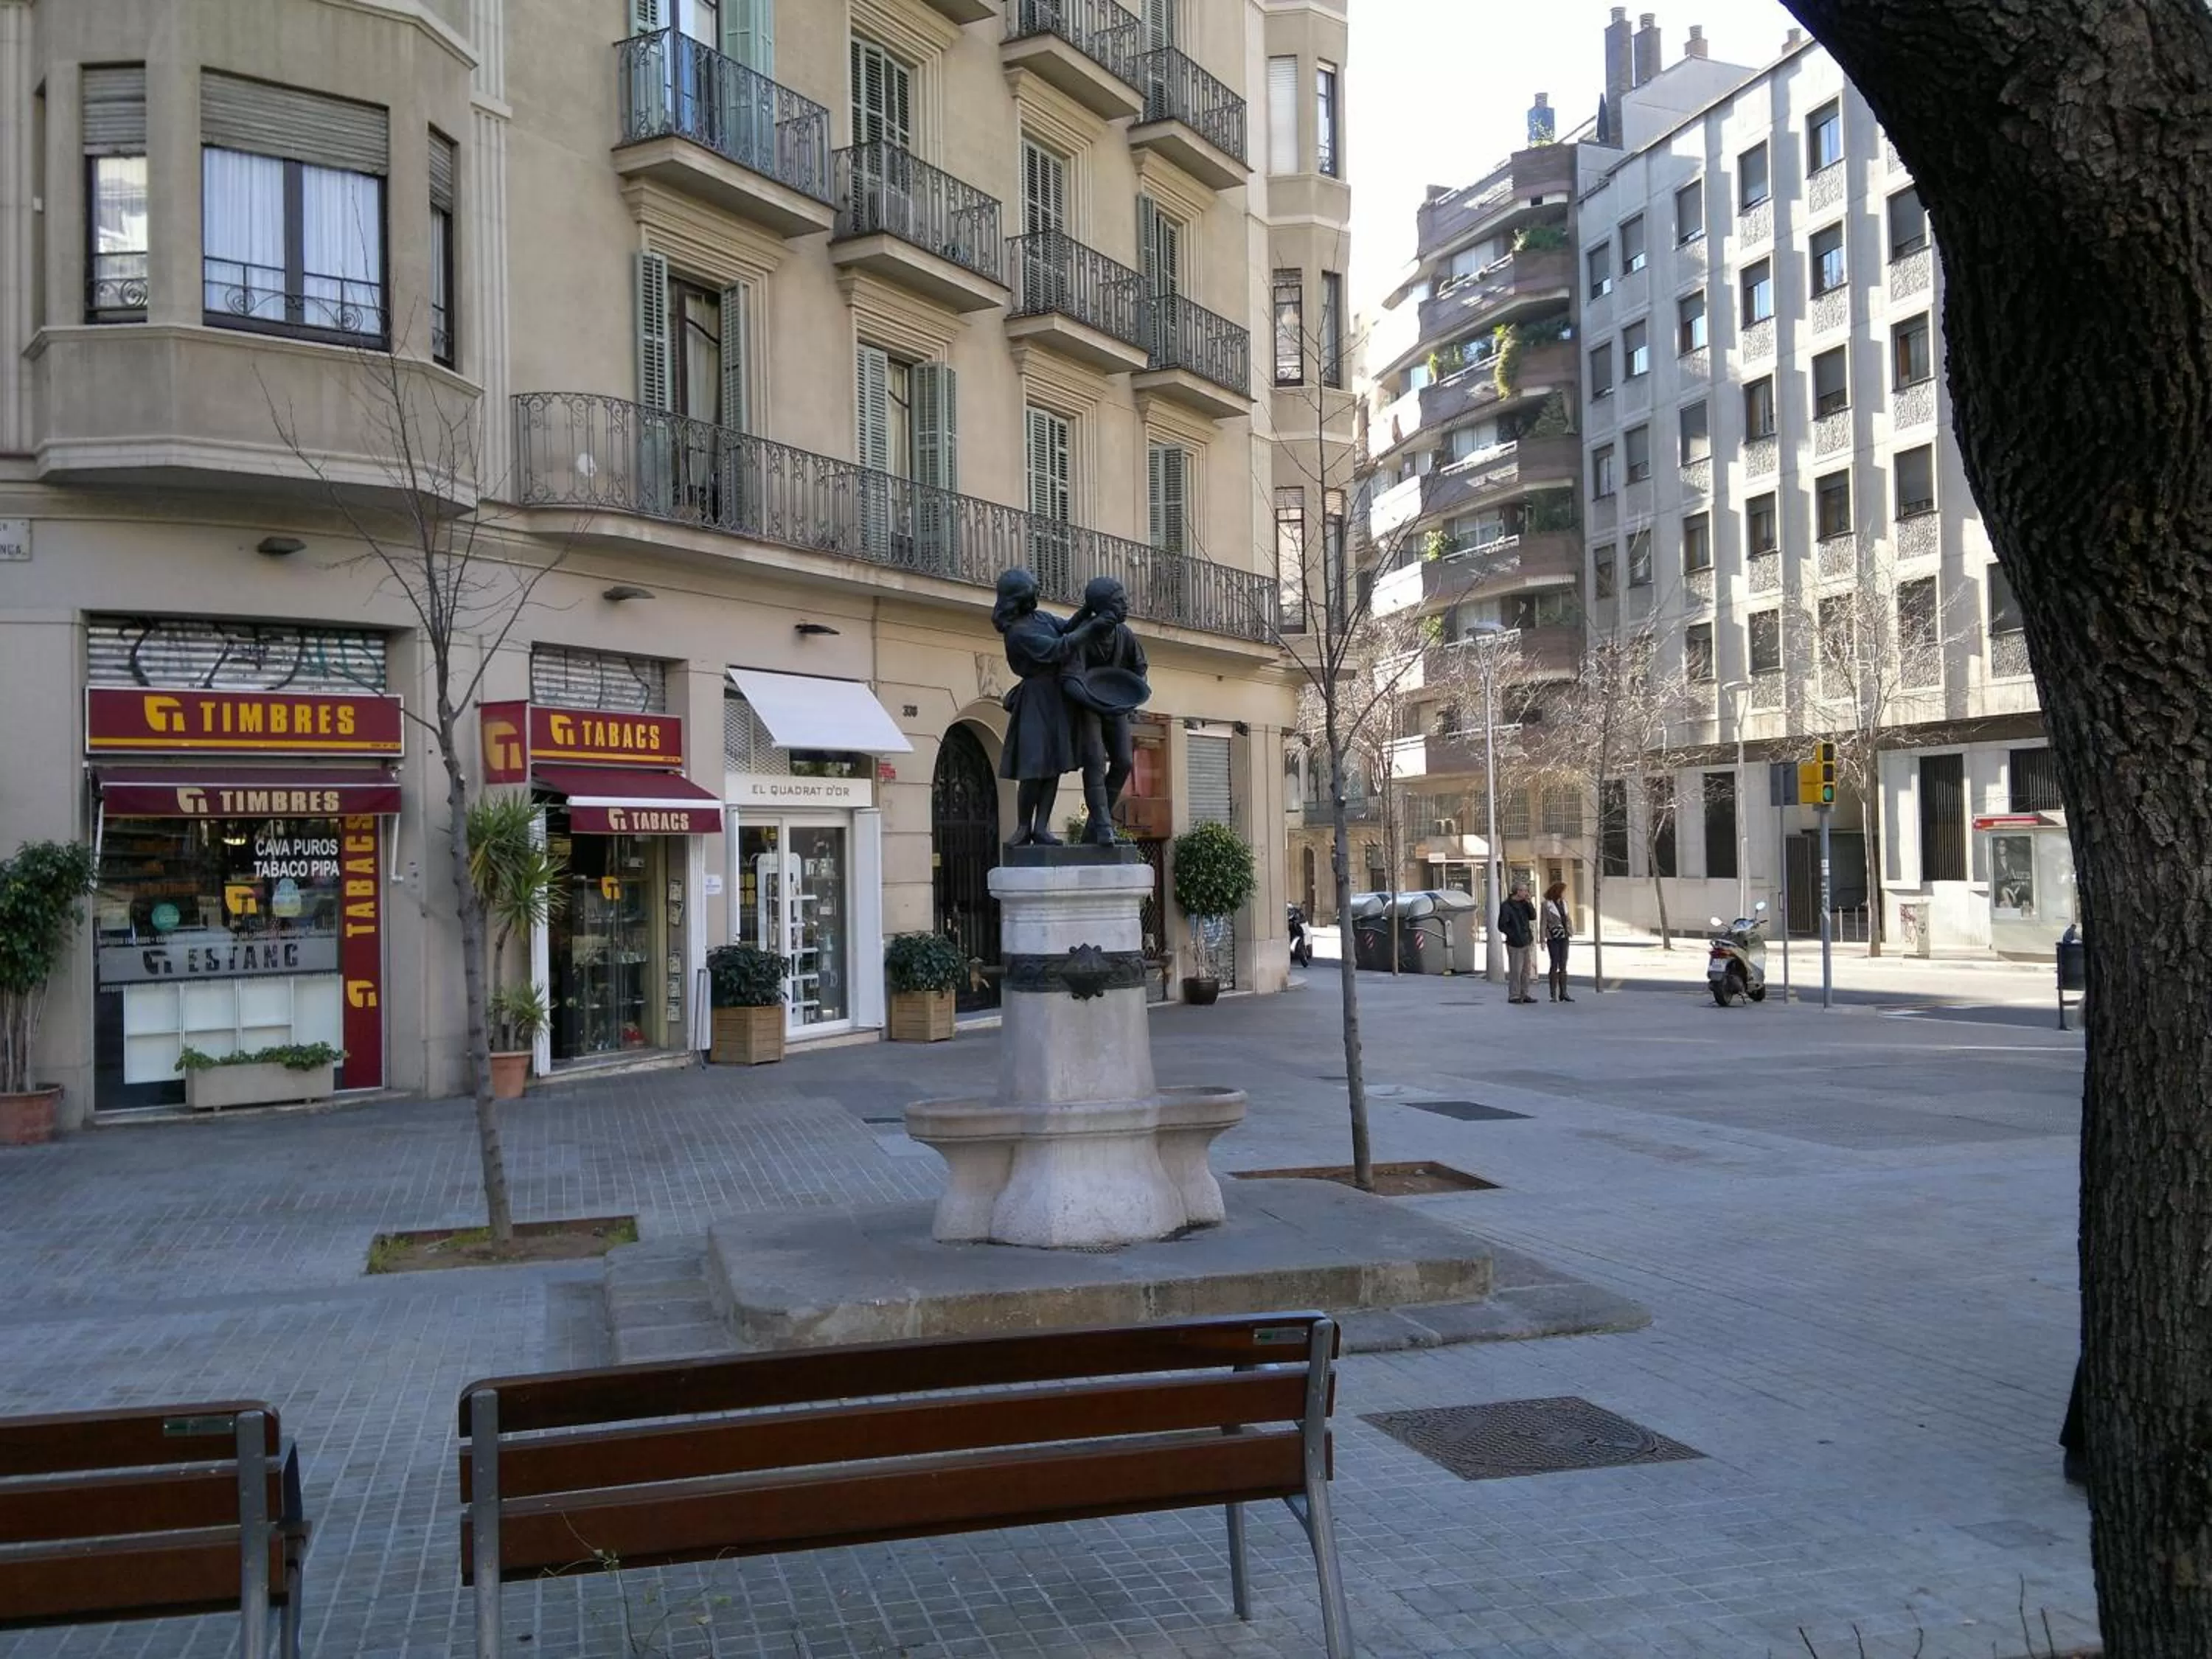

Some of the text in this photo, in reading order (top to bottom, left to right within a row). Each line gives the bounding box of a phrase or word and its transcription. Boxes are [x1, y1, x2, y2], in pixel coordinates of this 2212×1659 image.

[200, 701, 355, 734] TIMBRES
[581, 720, 661, 751] TABACS
[220, 790, 340, 813] TIMBRES
[751, 784, 850, 797] EL QUADRAT D'OR
[633, 812, 689, 831] TABACS
[255, 838, 338, 856] CAVA PUROS
[253, 860, 341, 878] TABACO PIPA
[345, 815, 375, 939] TABACS
[187, 942, 299, 973] ESTANC
